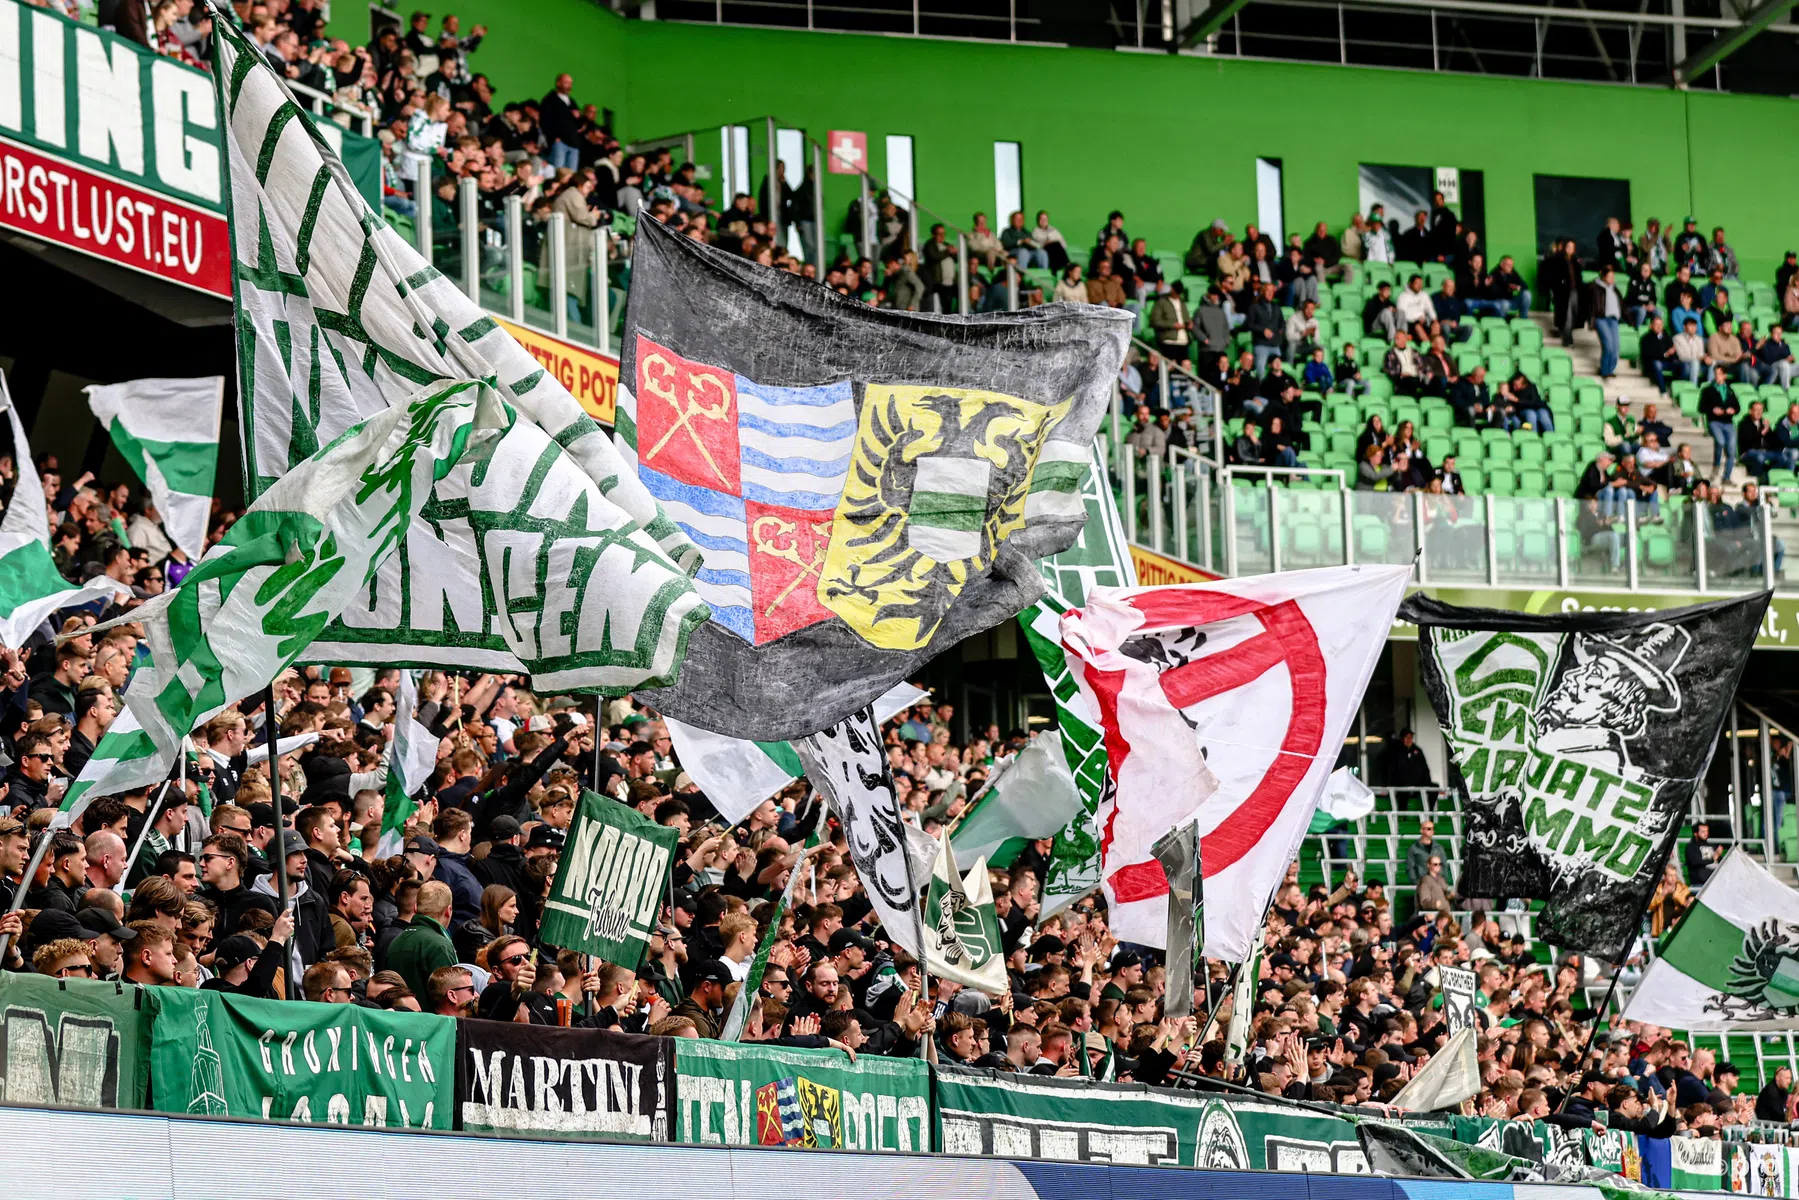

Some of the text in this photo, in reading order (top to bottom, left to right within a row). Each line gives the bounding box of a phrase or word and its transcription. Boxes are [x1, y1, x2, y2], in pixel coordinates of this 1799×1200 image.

[0, 154, 203, 275] RSTLUST.EU
[579, 364, 617, 411] POT
[562, 815, 670, 928] NOORD
[258, 1025, 436, 1083] GRONINGEN
[469, 1047, 644, 1119] MARTINI
